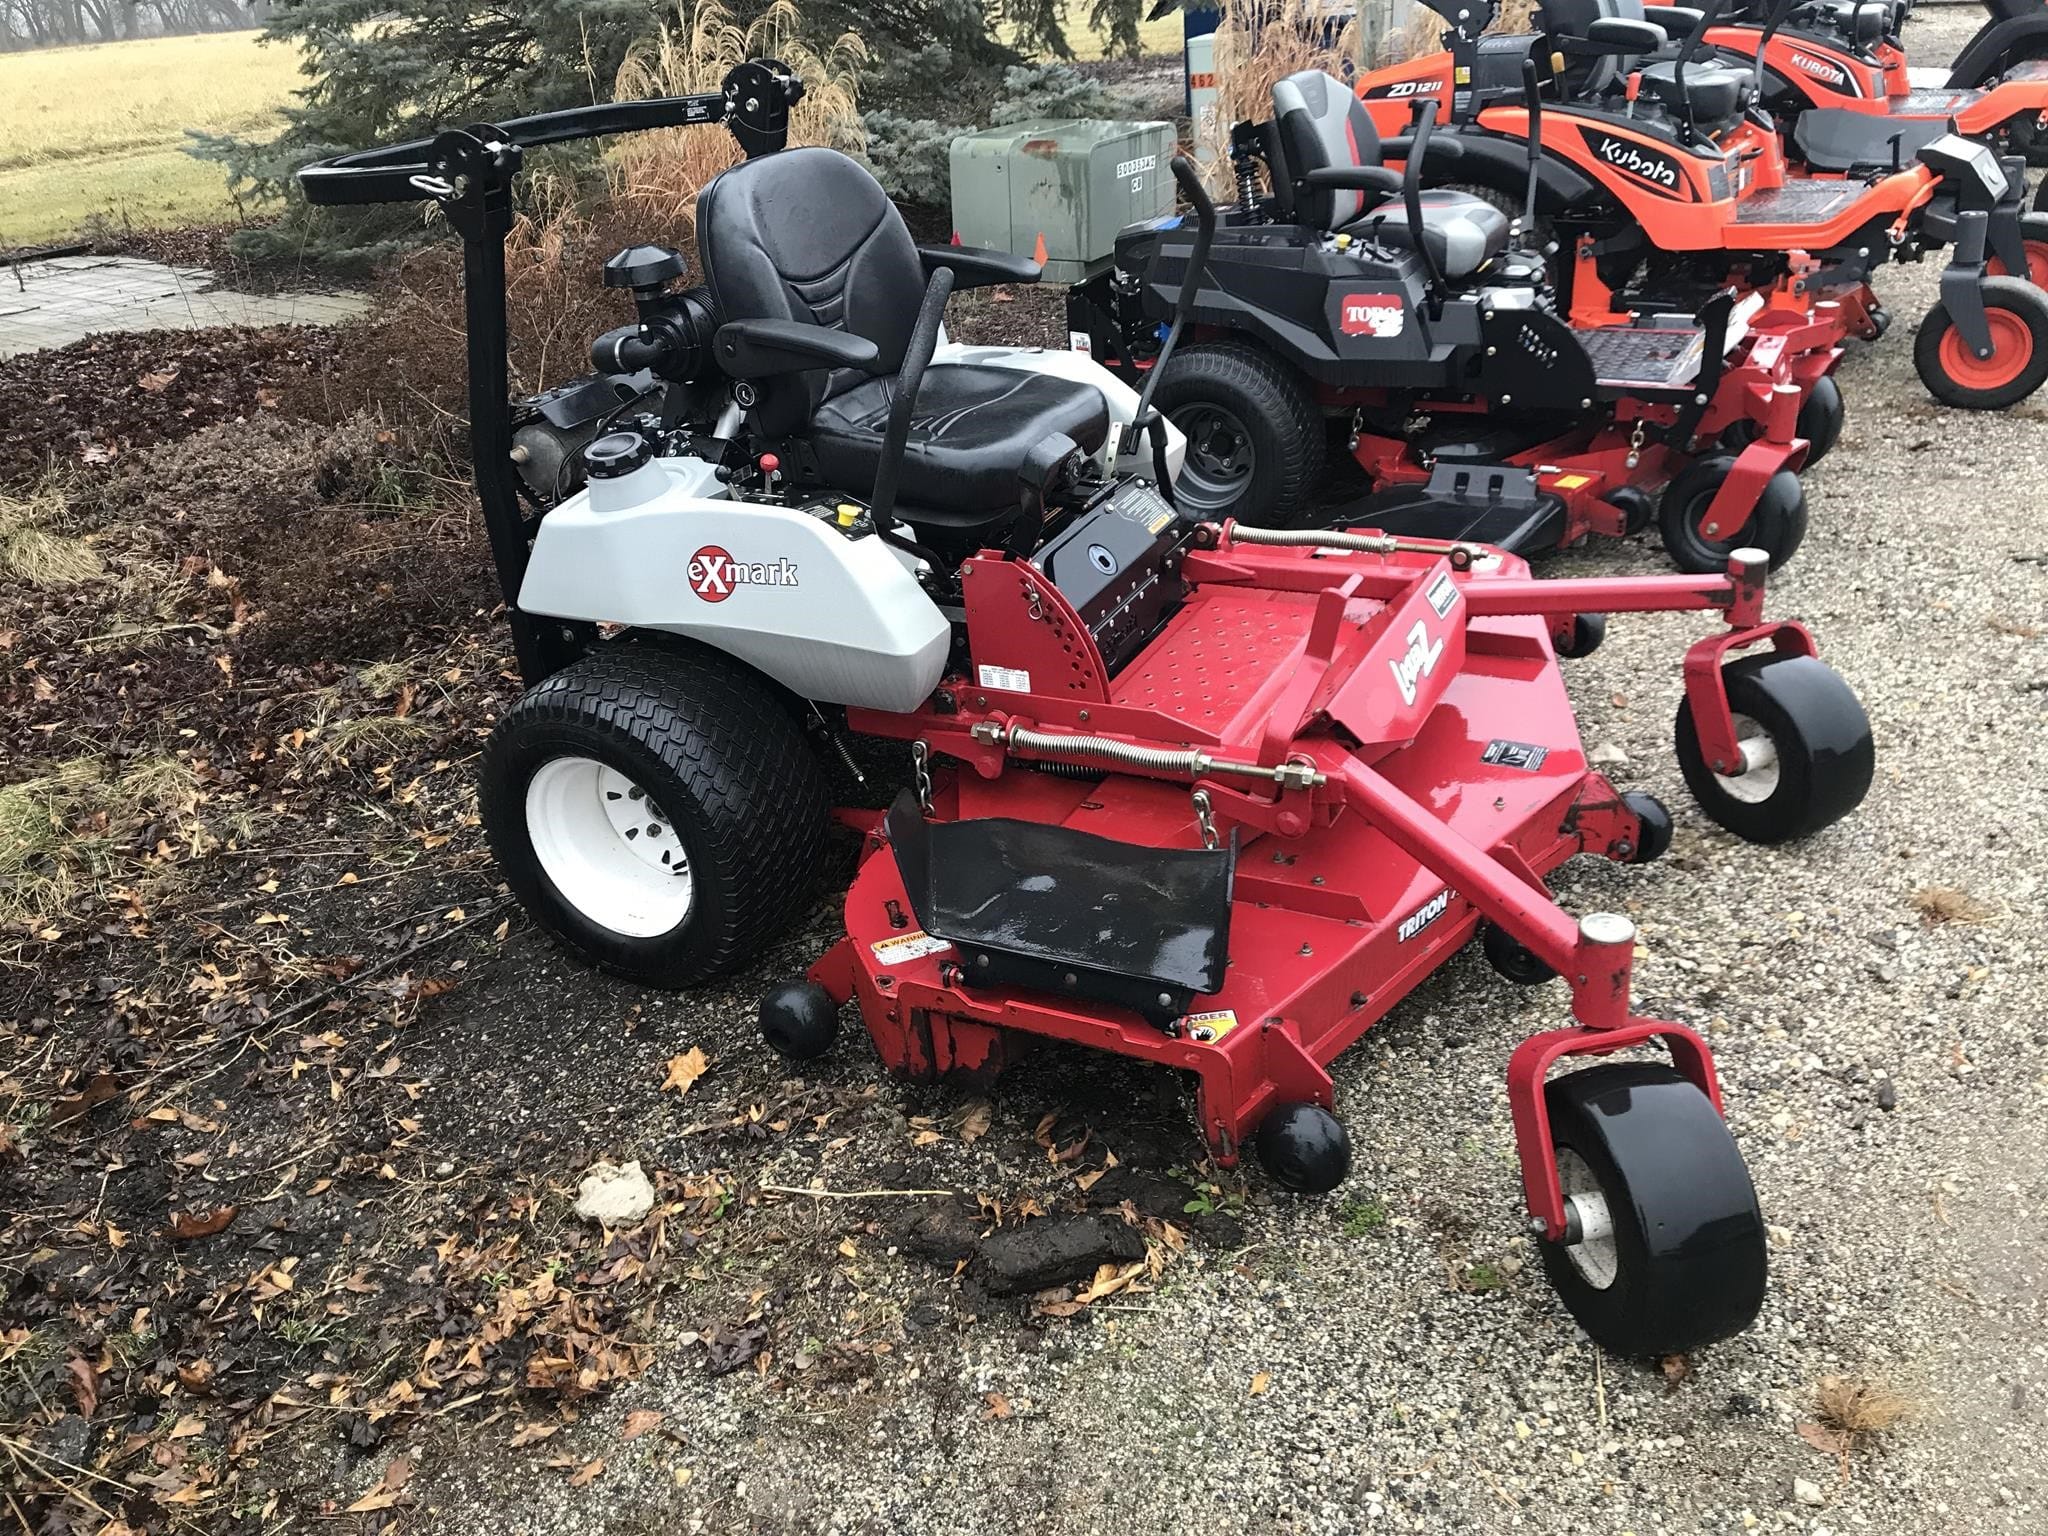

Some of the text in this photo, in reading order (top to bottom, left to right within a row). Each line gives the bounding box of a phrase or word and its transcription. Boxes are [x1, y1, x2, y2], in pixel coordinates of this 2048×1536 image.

[1191, 74, 1214, 88] 462
[1791, 53, 1845, 85] KUBOTA
[1601, 138, 1676, 185] Kubota
[1398, 890, 1448, 943] TRITON
